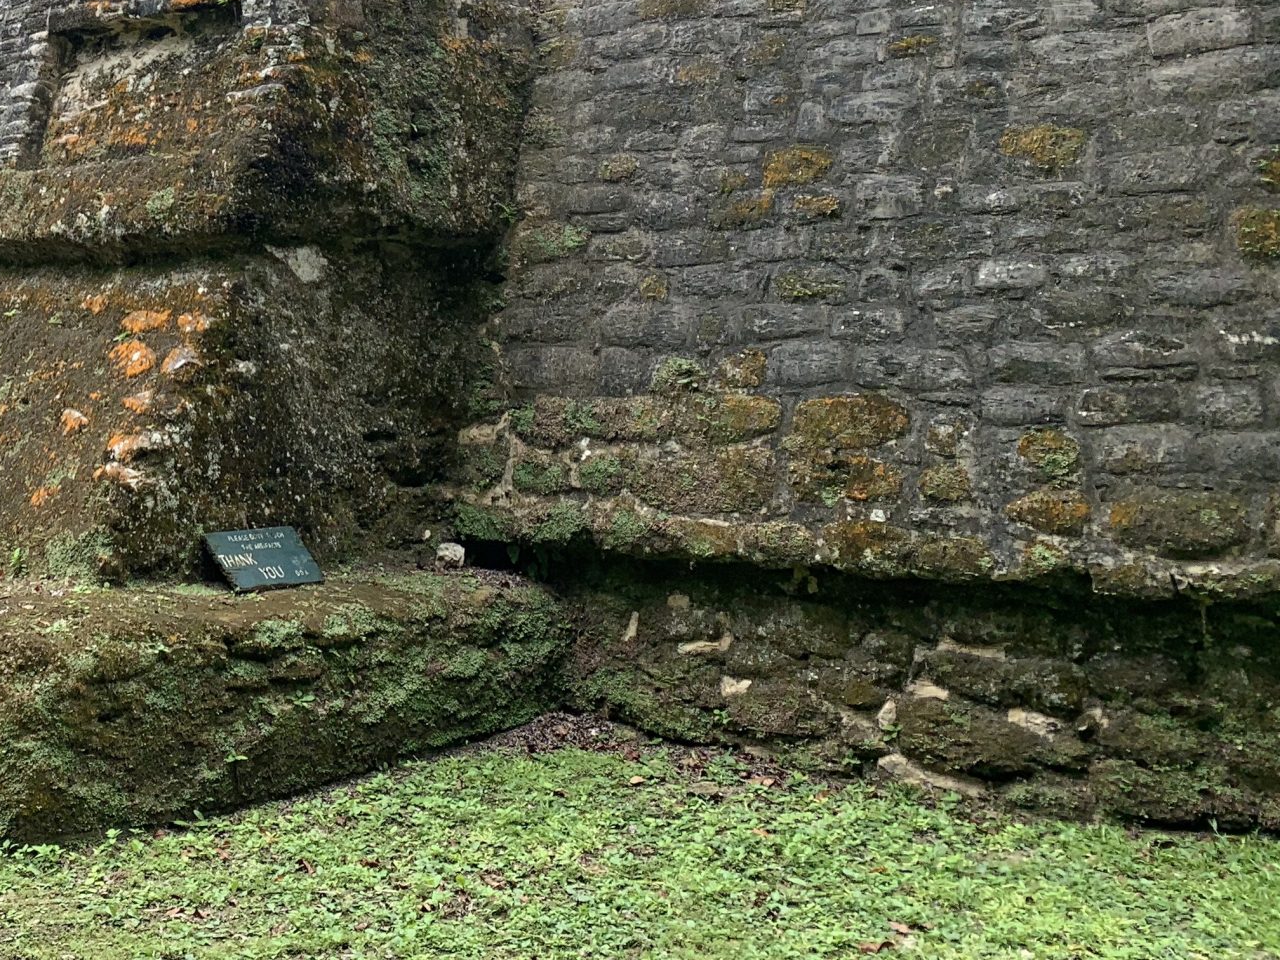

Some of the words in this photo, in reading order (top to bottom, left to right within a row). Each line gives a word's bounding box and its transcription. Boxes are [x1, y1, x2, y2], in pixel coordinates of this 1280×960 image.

[227, 534, 249, 542] PLEASE
[241, 543, 253, 551] THE
[218, 552, 257, 568] THANK
[258, 565, 285, 580] YOU
